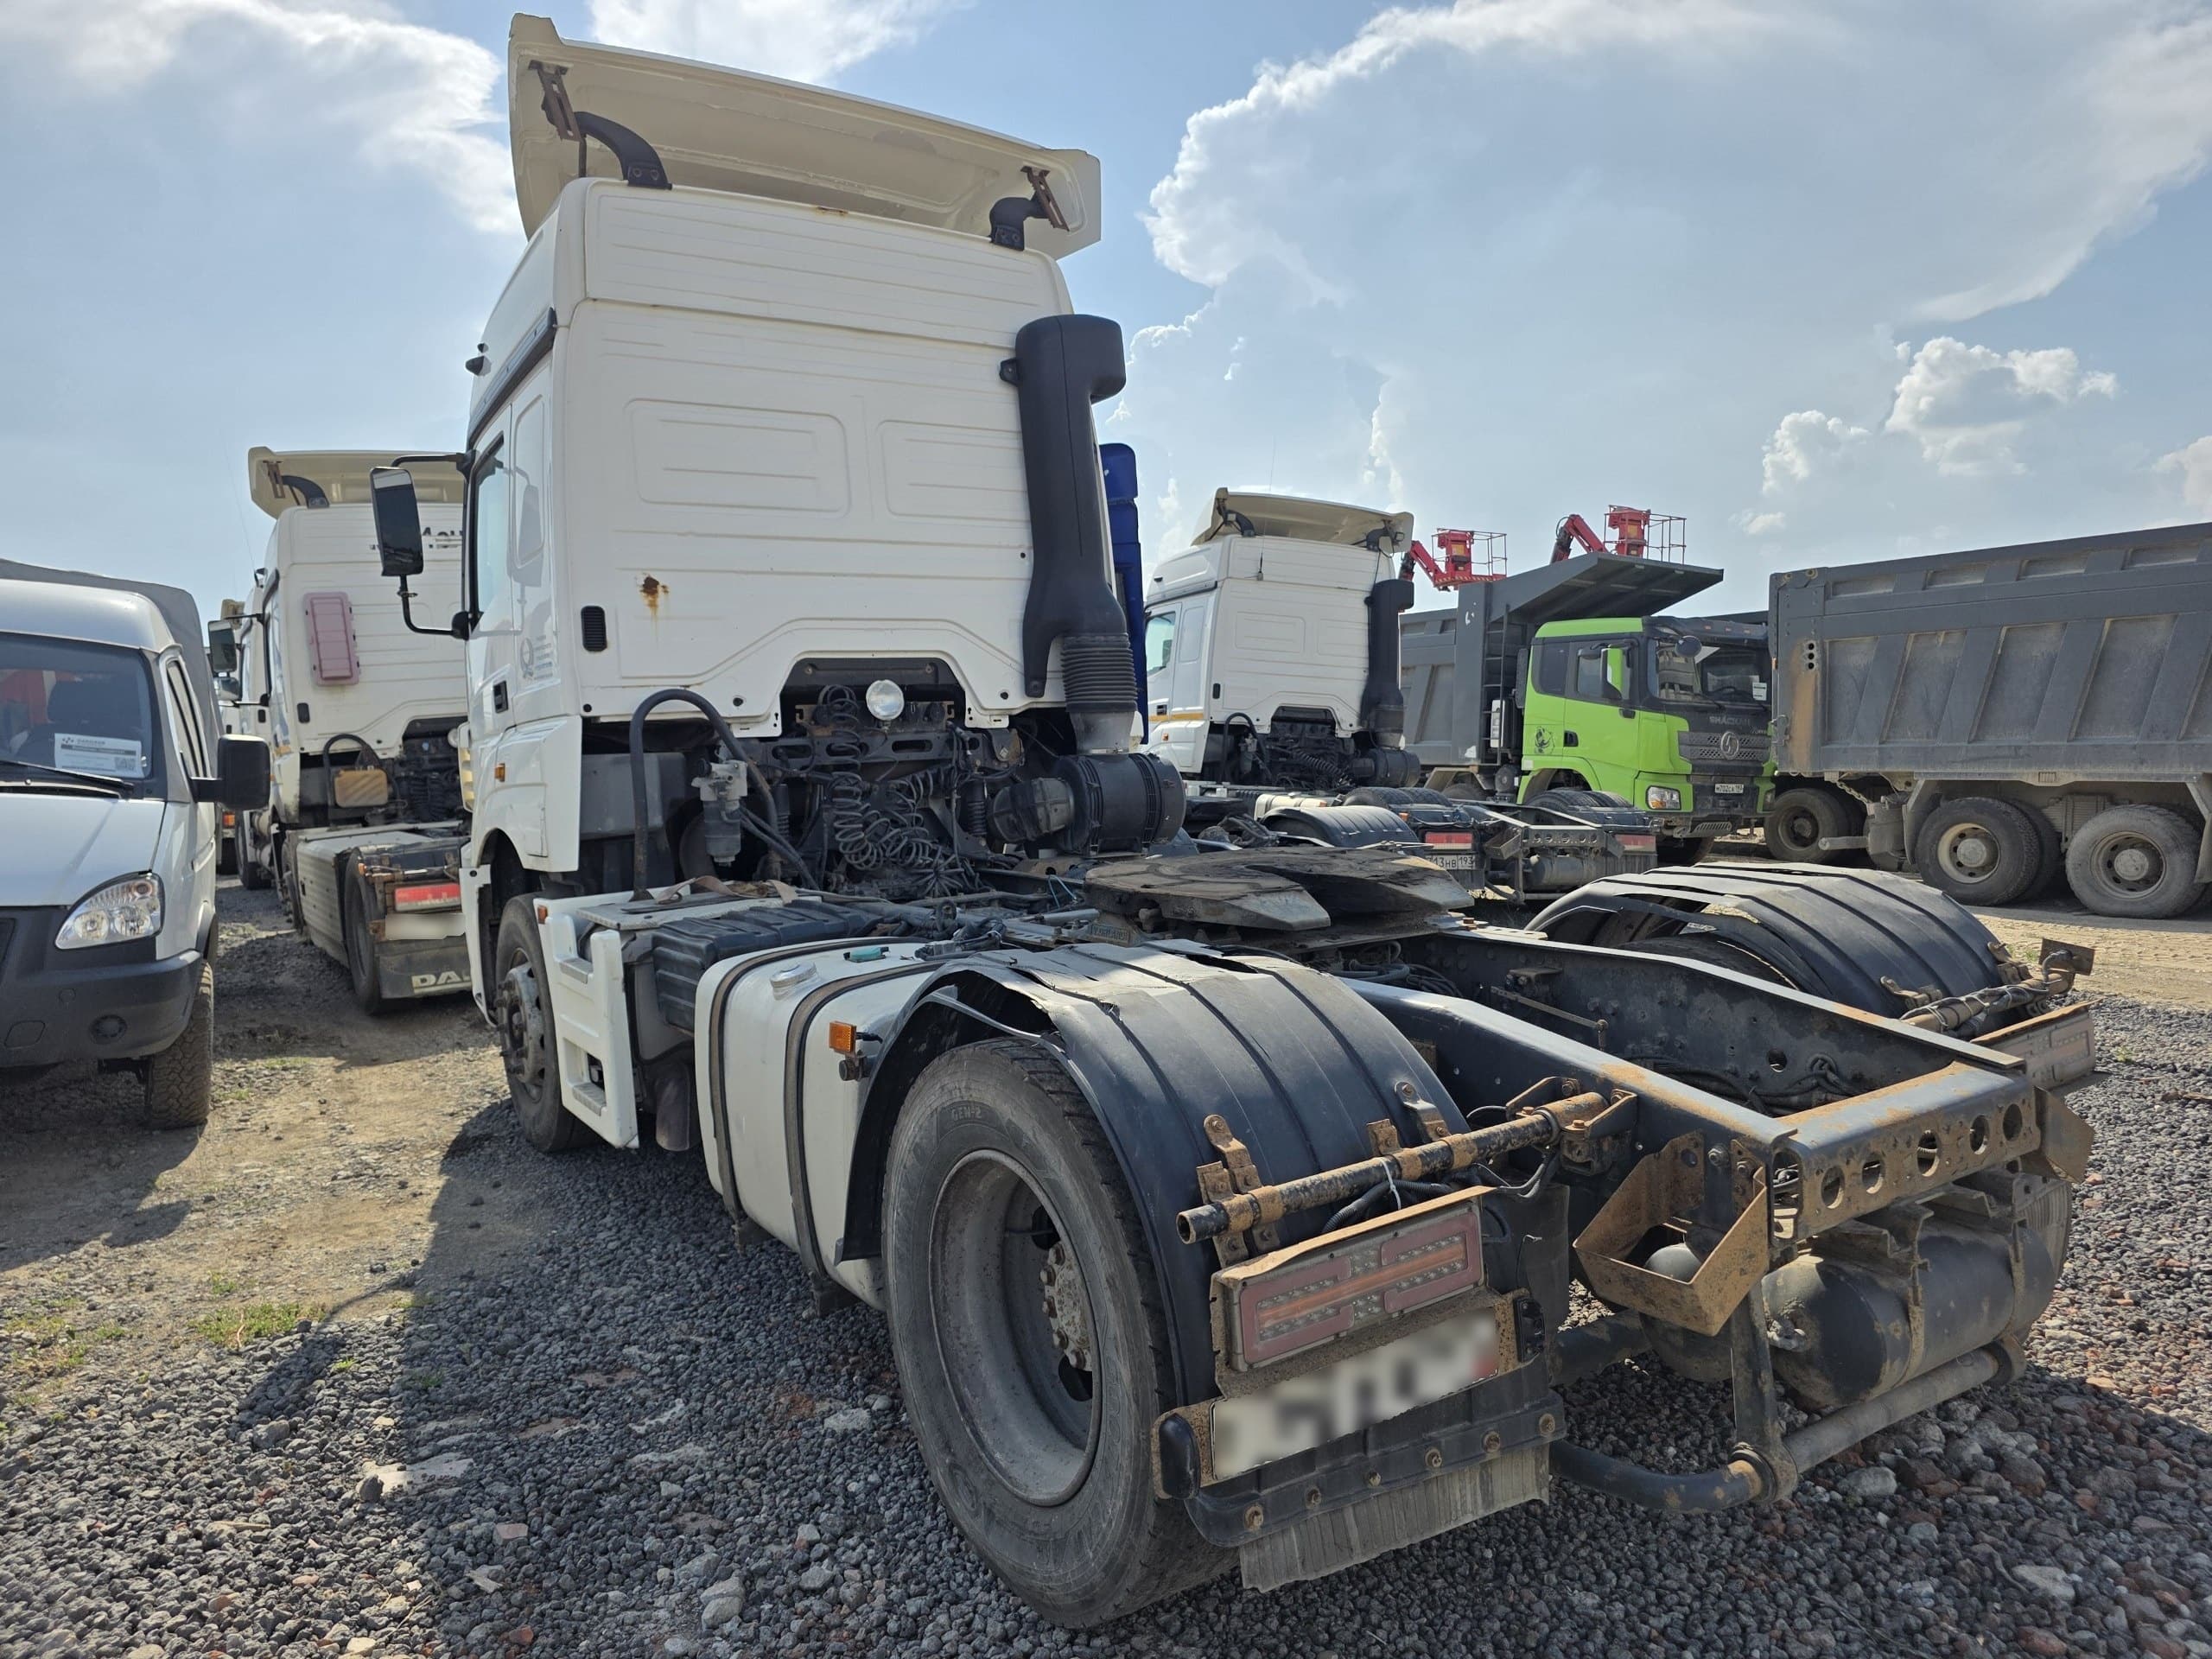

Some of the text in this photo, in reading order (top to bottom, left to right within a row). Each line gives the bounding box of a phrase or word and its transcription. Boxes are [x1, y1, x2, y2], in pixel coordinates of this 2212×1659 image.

[1459, 856, 1473, 865] 193
[411, 971, 471, 988] DA
[951, 1105, 982, 1122] GEN-2
